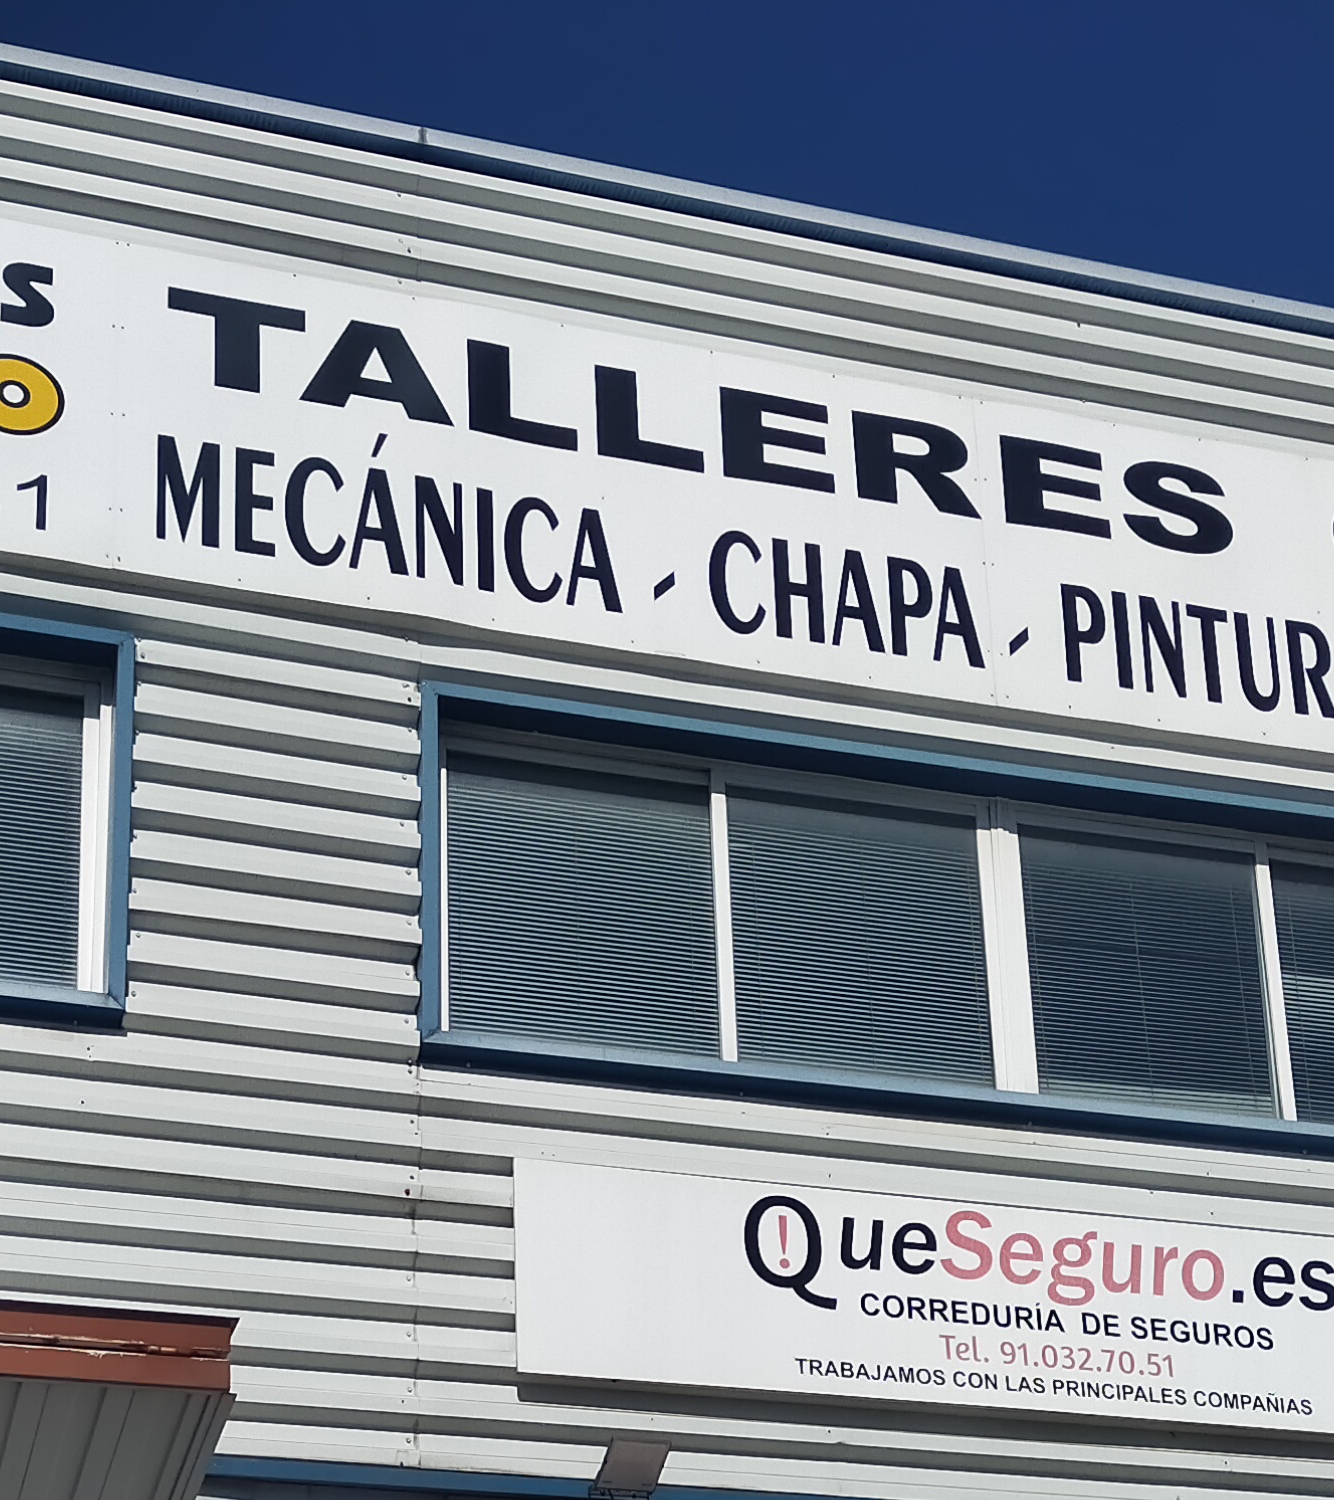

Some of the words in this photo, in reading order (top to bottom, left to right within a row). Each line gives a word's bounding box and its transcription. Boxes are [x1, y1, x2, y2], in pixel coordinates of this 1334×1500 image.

[168, 286, 1234, 555] TALLERES
[157, 433, 623, 613] MECÁNICA
[708, 529, 986, 669] CHAPA
[860, 1292, 1065, 1334] CORREDURÍA
[1081, 1312, 1122, 1338] DE
[1131, 1316, 1275, 1351] SEGUROS
[939, 1334, 991, 1364] Tel.
[1000, 1341, 1175, 1378] 91.032.70.51
[795, 1358, 946, 1387] TRABAJAMOS
[953, 1371, 1000, 1391] CON
[1006, 1376, 1046, 1395] LAS
[1053, 1378, 1187, 1406] PRINCIPALES
[1193, 1390, 1313, 1416] COMPAÑIAS
